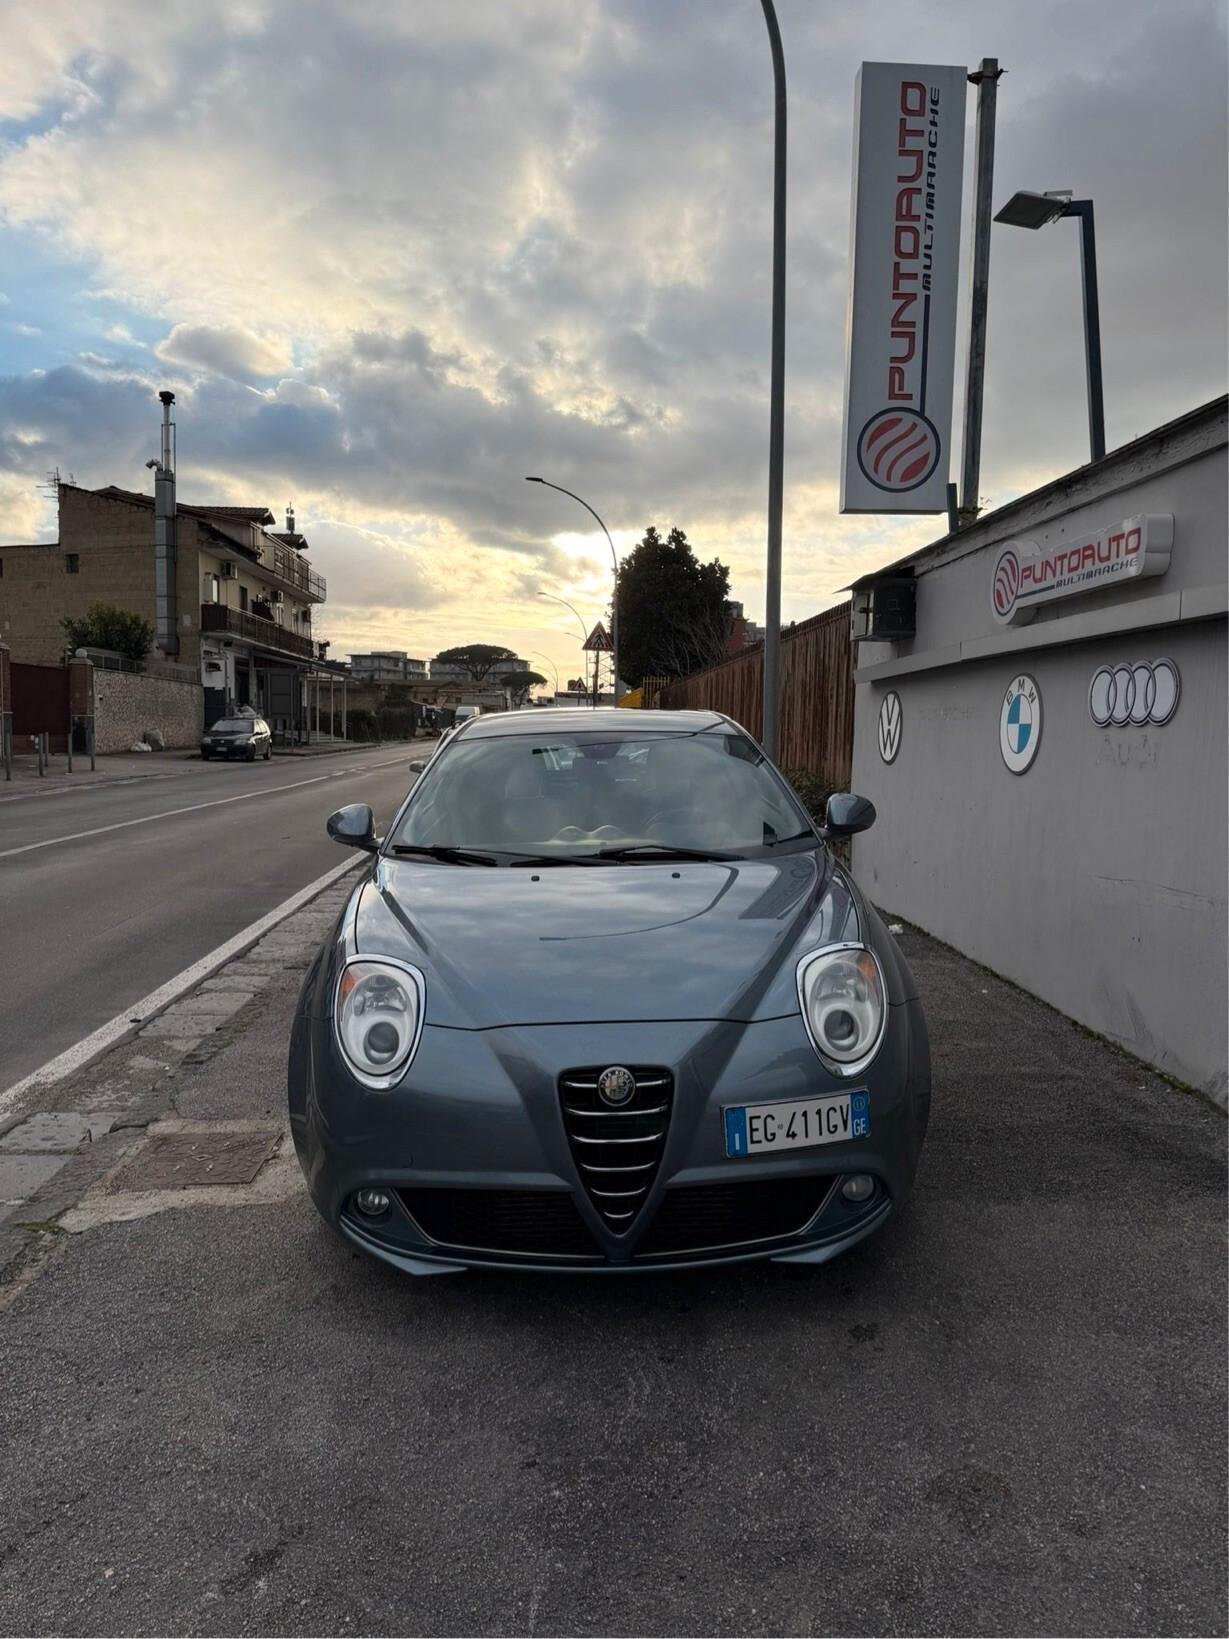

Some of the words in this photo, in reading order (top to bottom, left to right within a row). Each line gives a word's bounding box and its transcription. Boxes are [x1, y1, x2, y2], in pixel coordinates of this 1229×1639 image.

[923, 87, 940, 292] MULTIMARCHE
[888, 81, 926, 401] PUNTOAUTO
[1020, 527, 1141, 588] PUNTOAUTO
[1056, 557, 1138, 589] MULTIMARCHE
[1007, 679, 1036, 705] BMW
[853, 1118, 866, 1136] GE
